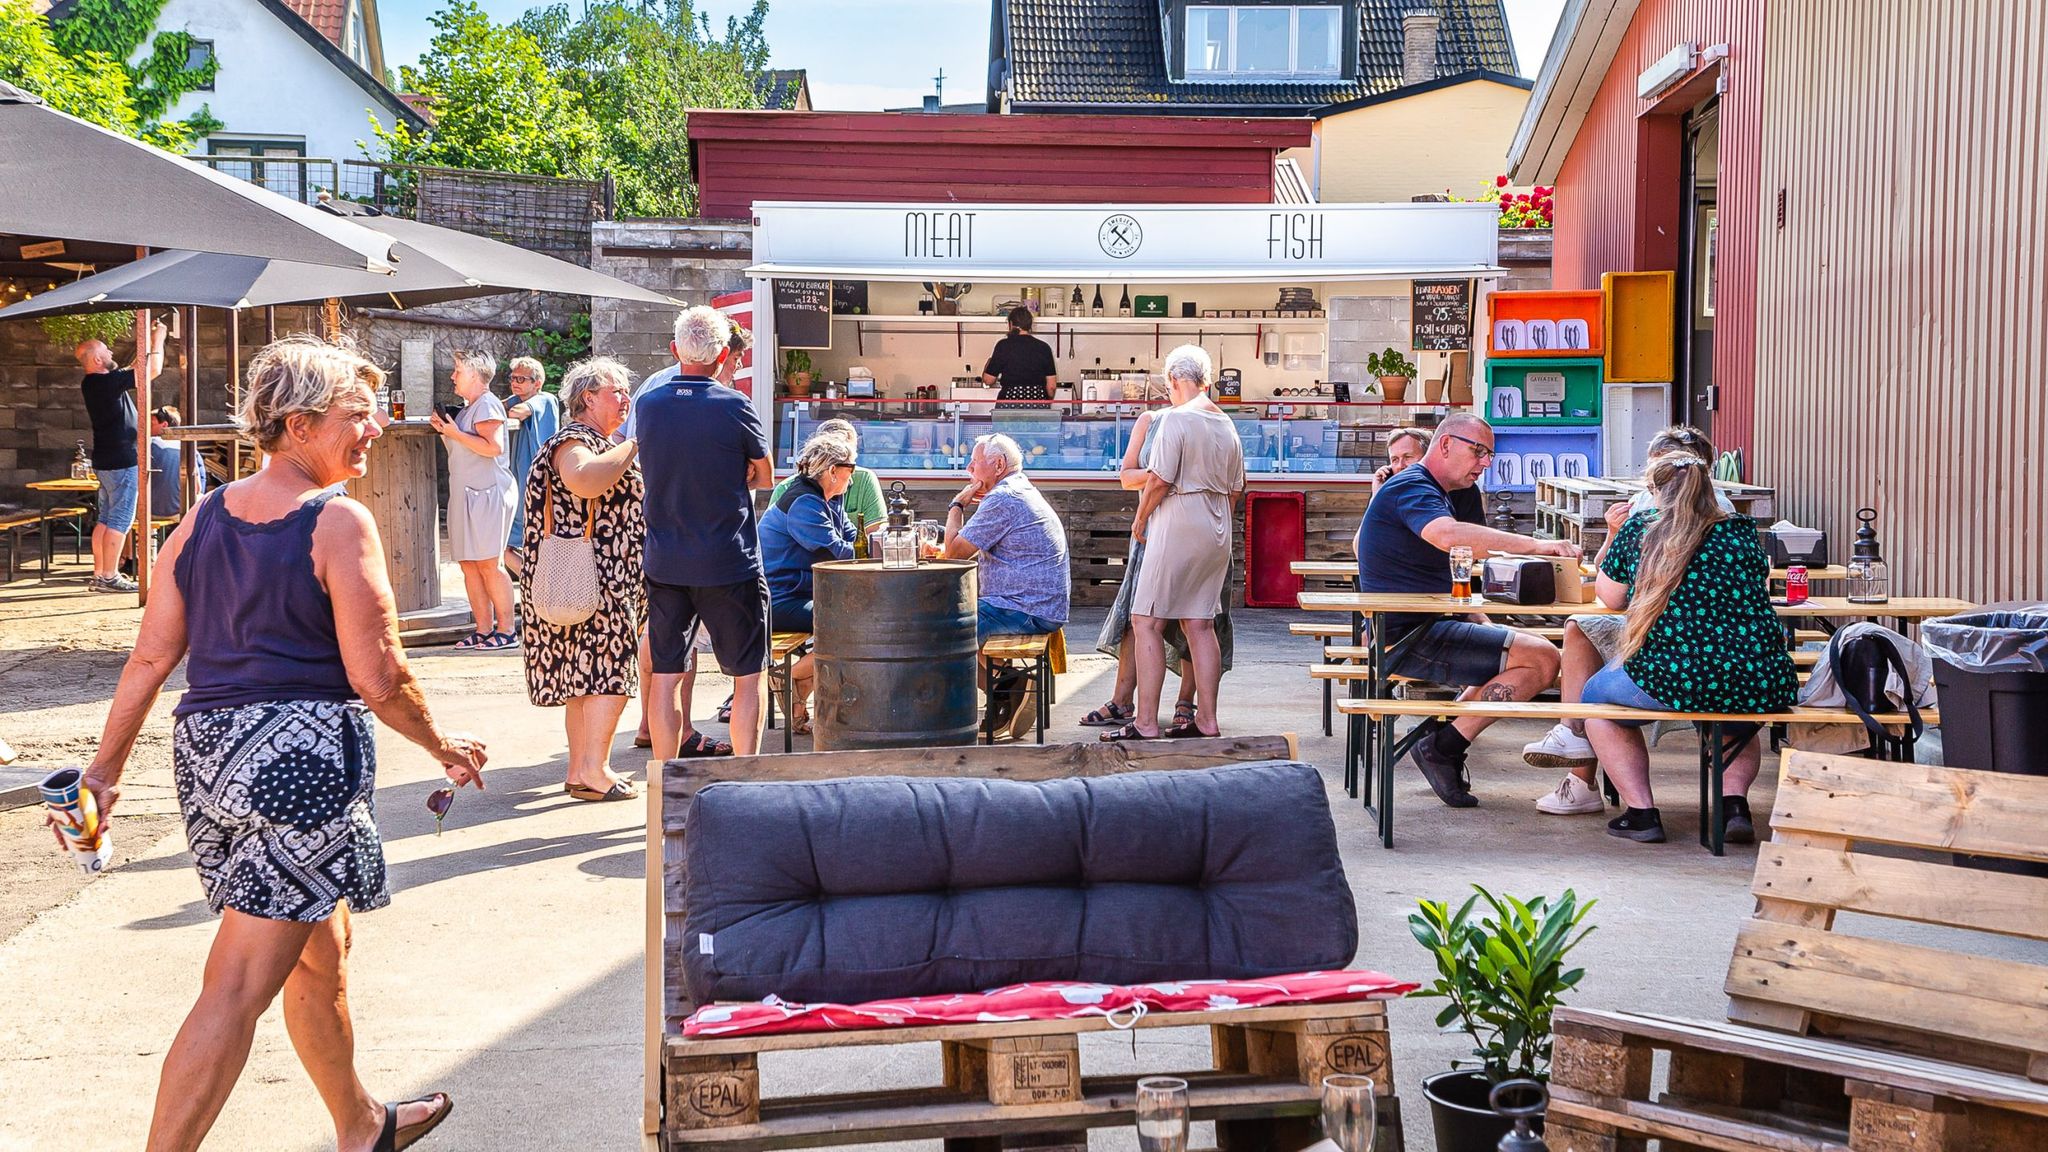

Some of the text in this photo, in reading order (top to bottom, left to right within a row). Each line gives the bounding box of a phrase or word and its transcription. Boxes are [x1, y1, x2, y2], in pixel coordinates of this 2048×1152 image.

[905, 212, 976, 258] MEAT
[1267, 213, 1323, 259] FISH
[676, 388, 693, 396] BOSS
[1333, 1044, 1377, 1068] EPAL
[699, 1084, 744, 1110] EPAL
